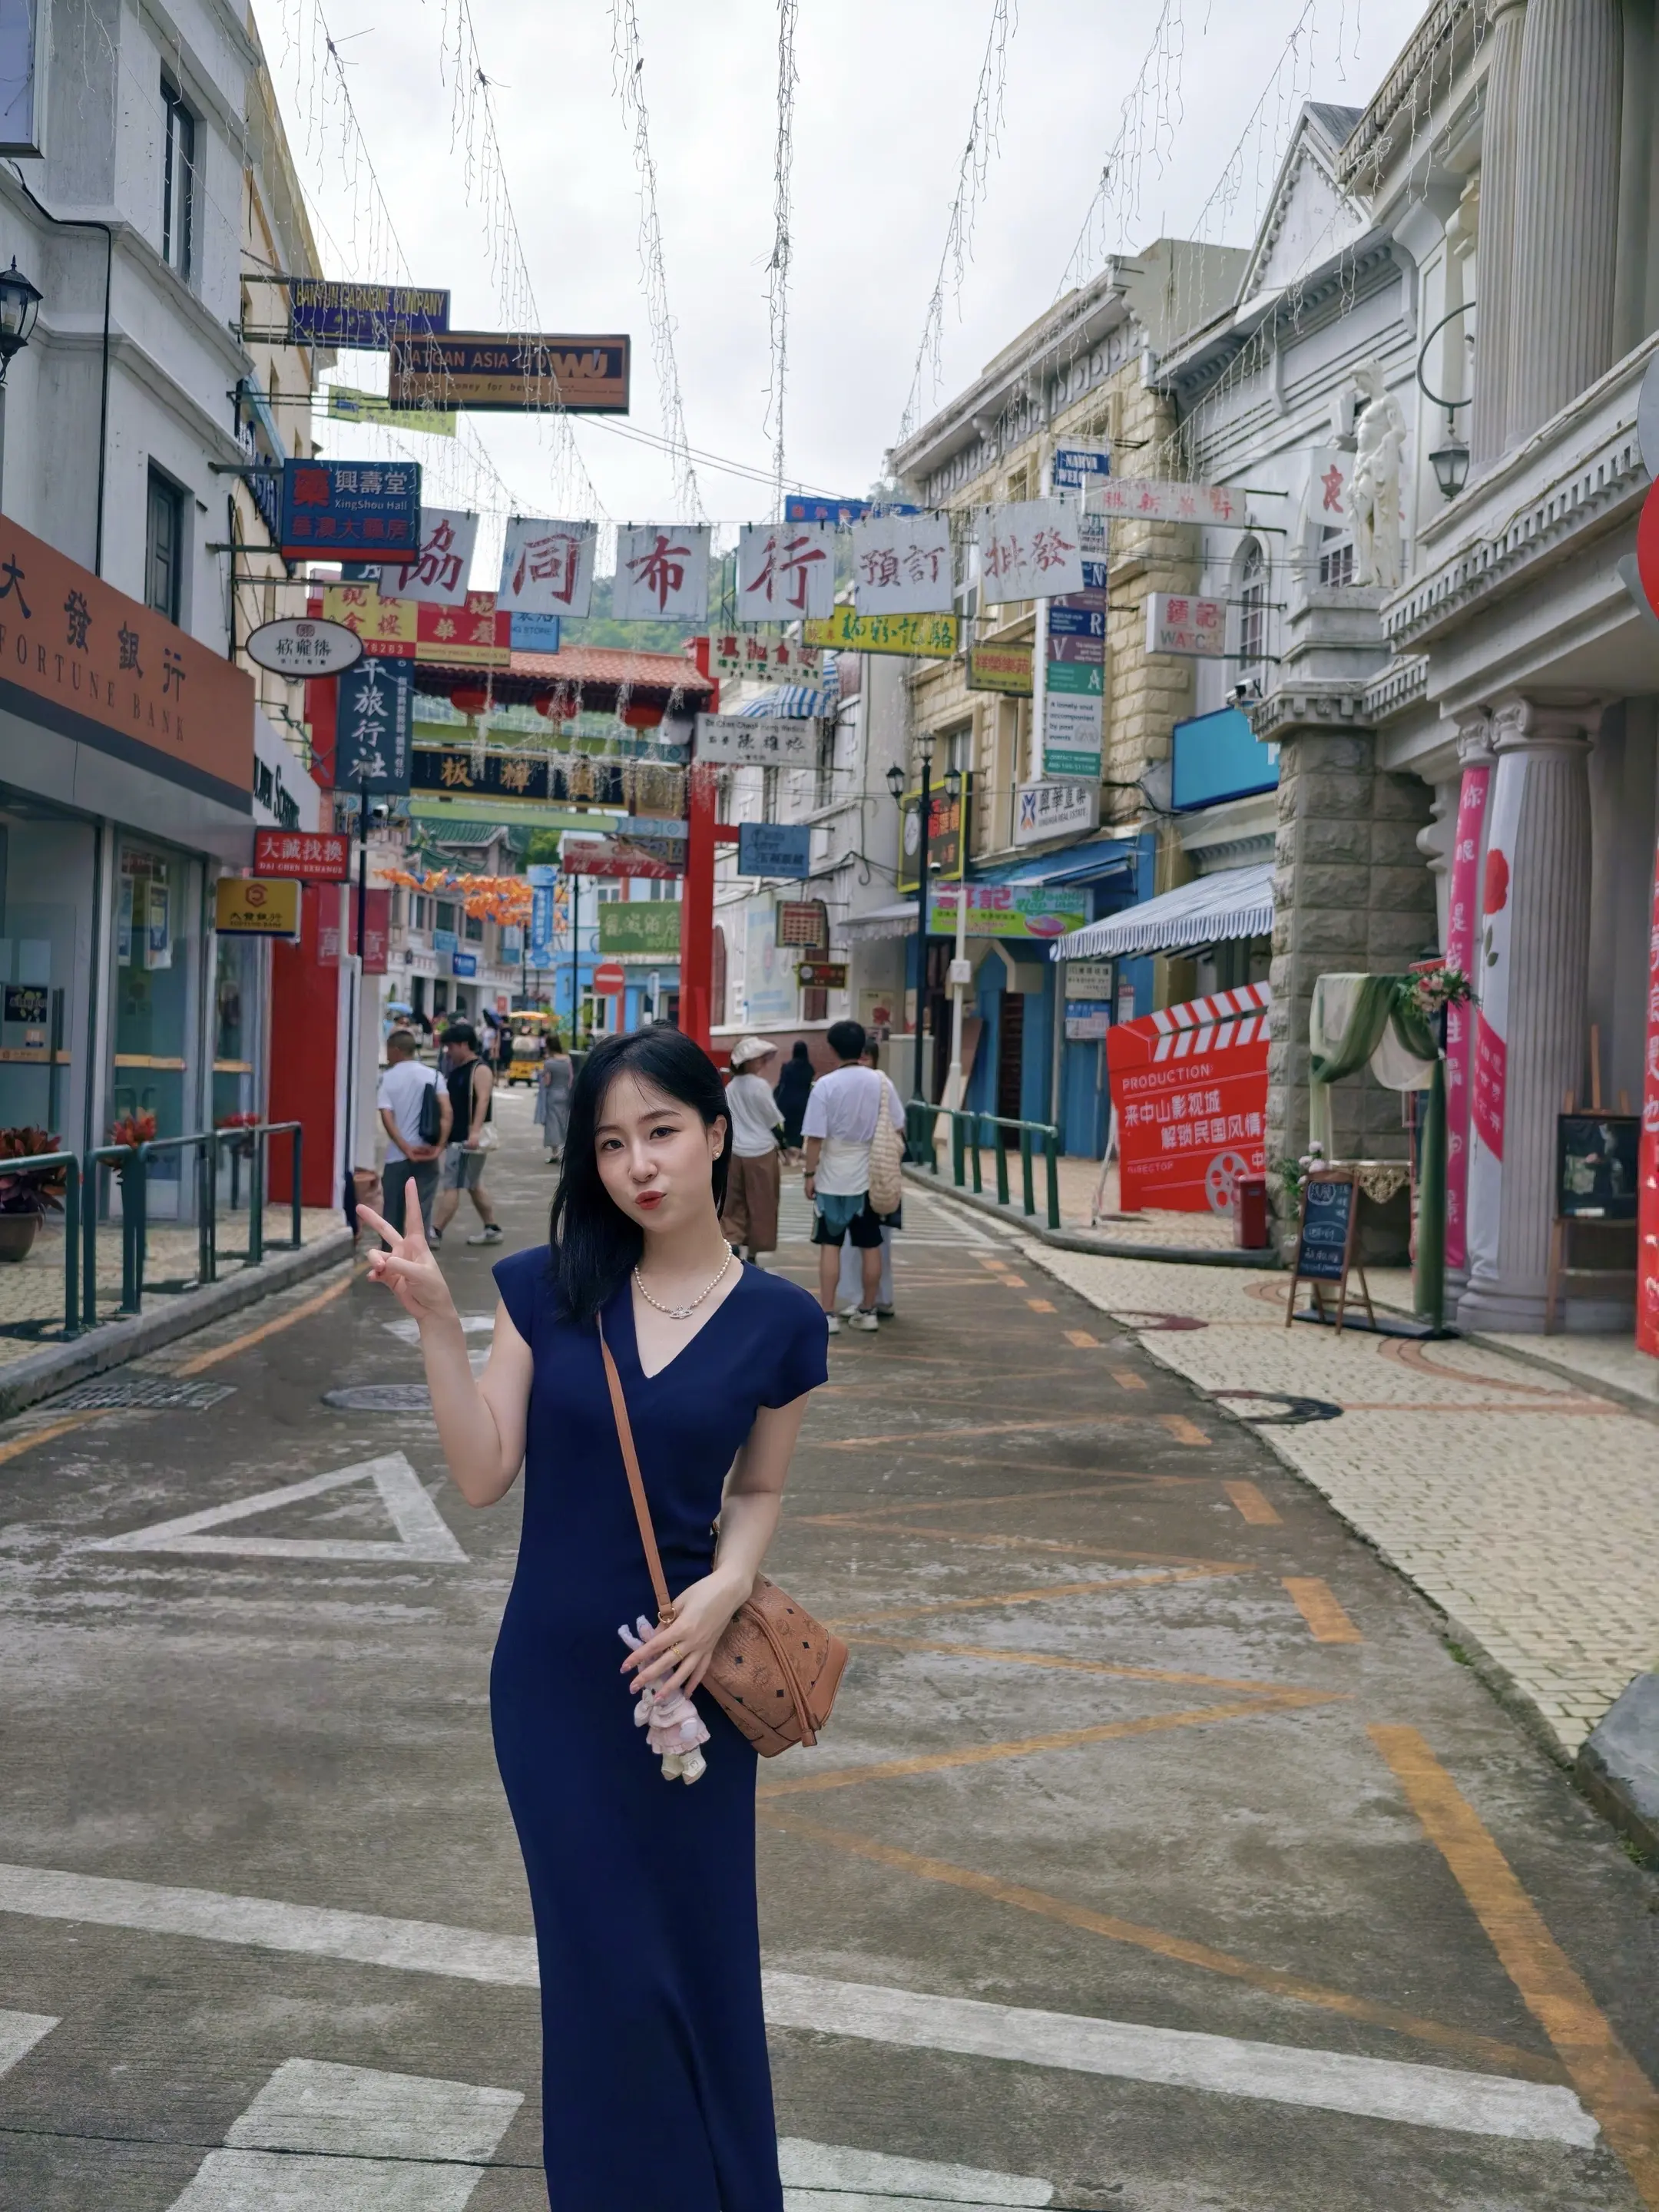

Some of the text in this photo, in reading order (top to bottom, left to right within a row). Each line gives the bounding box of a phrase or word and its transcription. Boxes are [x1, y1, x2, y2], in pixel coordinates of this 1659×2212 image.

[394, 289, 445, 317] COMPANY
[472, 352, 509, 369] ASIA
[487, 382, 502, 392] for
[335, 469, 407, 495] 興壽堂
[335, 499, 407, 511] XingShou Hall
[0, 553, 186, 703] 大發銀行
[523, 625, 553, 636] STORE
[1091, 612, 1102, 636] R
[1053, 637, 1068, 661] V
[133, 691, 184, 743] BANK
[1124, 1088, 1221, 1128] 来中山影视城
[1161, 1111, 1267, 1151] 解锁民国风情
